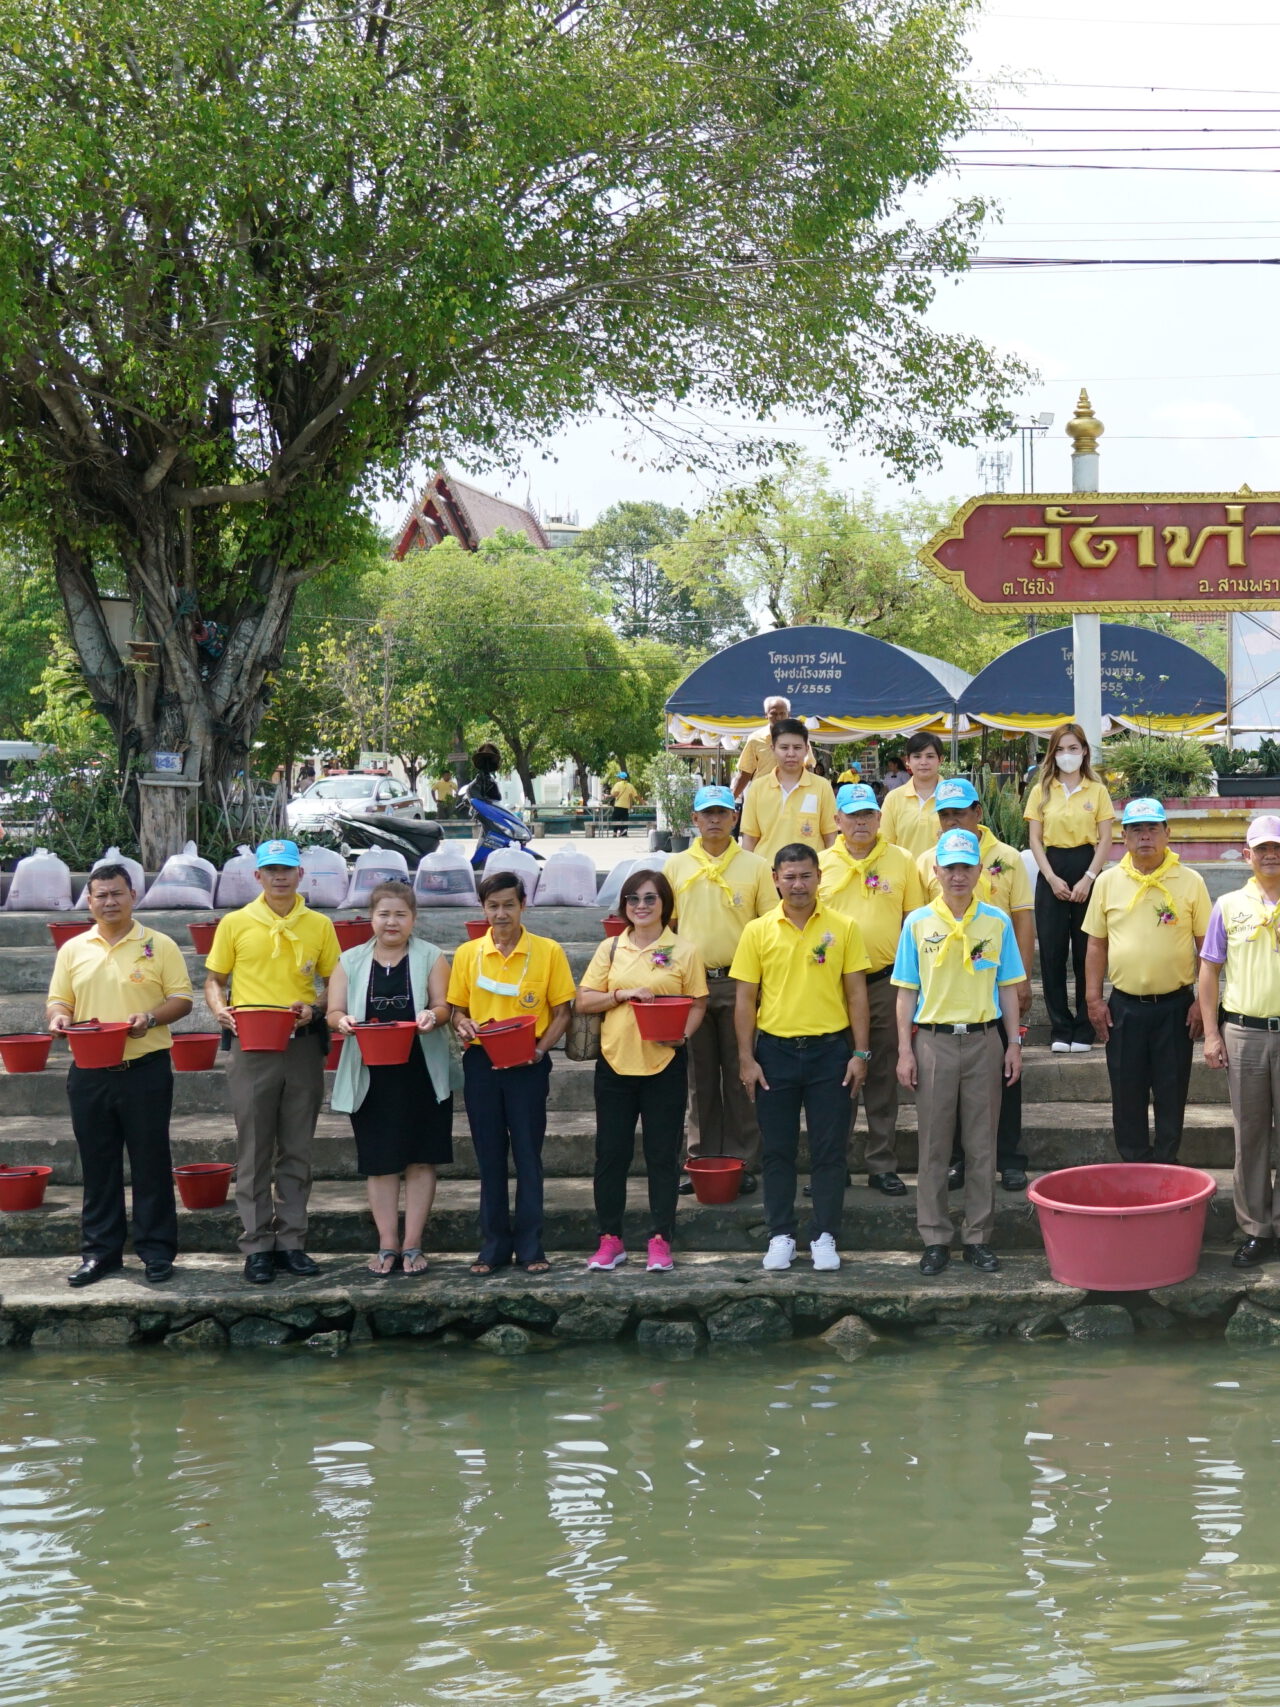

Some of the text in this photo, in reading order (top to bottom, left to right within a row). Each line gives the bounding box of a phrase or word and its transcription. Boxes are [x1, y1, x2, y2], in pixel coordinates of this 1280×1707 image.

[1199, 579, 1214, 592] อ.
[768, 651, 847, 664] โครงการ SML
[1110, 650, 1138, 662] SML
[786, 682, 832, 694] 5/2555
